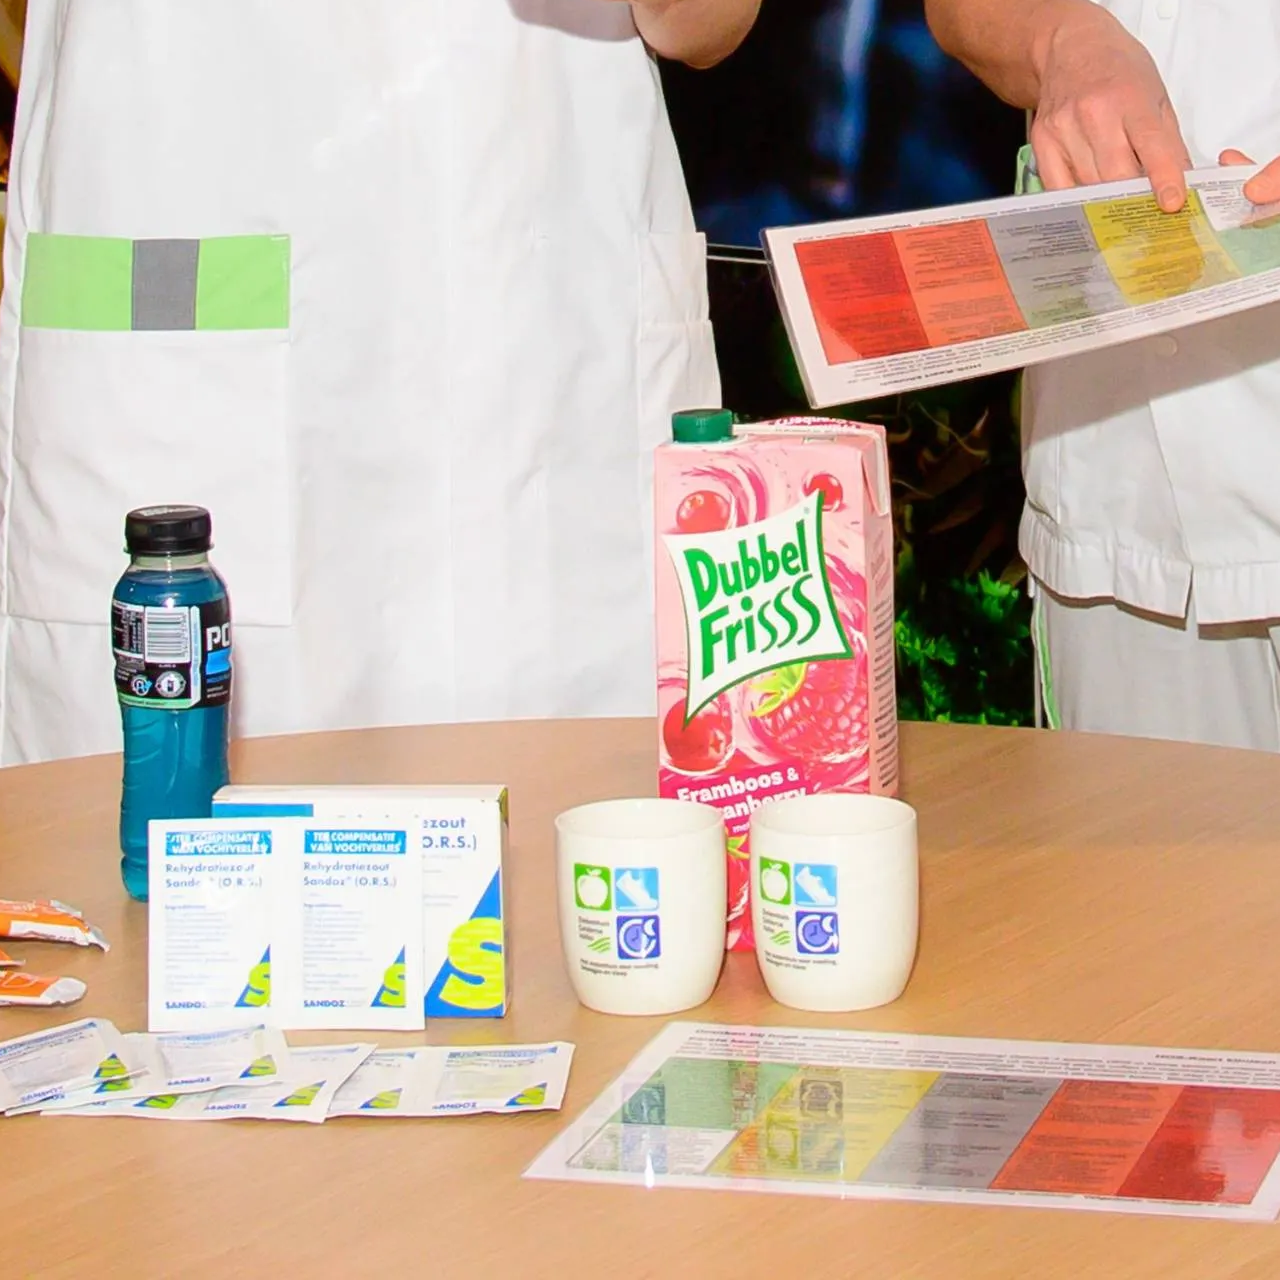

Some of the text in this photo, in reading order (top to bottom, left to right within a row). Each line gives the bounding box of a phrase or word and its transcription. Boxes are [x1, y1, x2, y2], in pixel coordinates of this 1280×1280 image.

[682, 518, 809, 613] Dubbel
[699, 573, 822, 681] Frisss
[676, 767, 800, 804] Framboos &
[303, 861, 390, 873] Rehydratiezout
